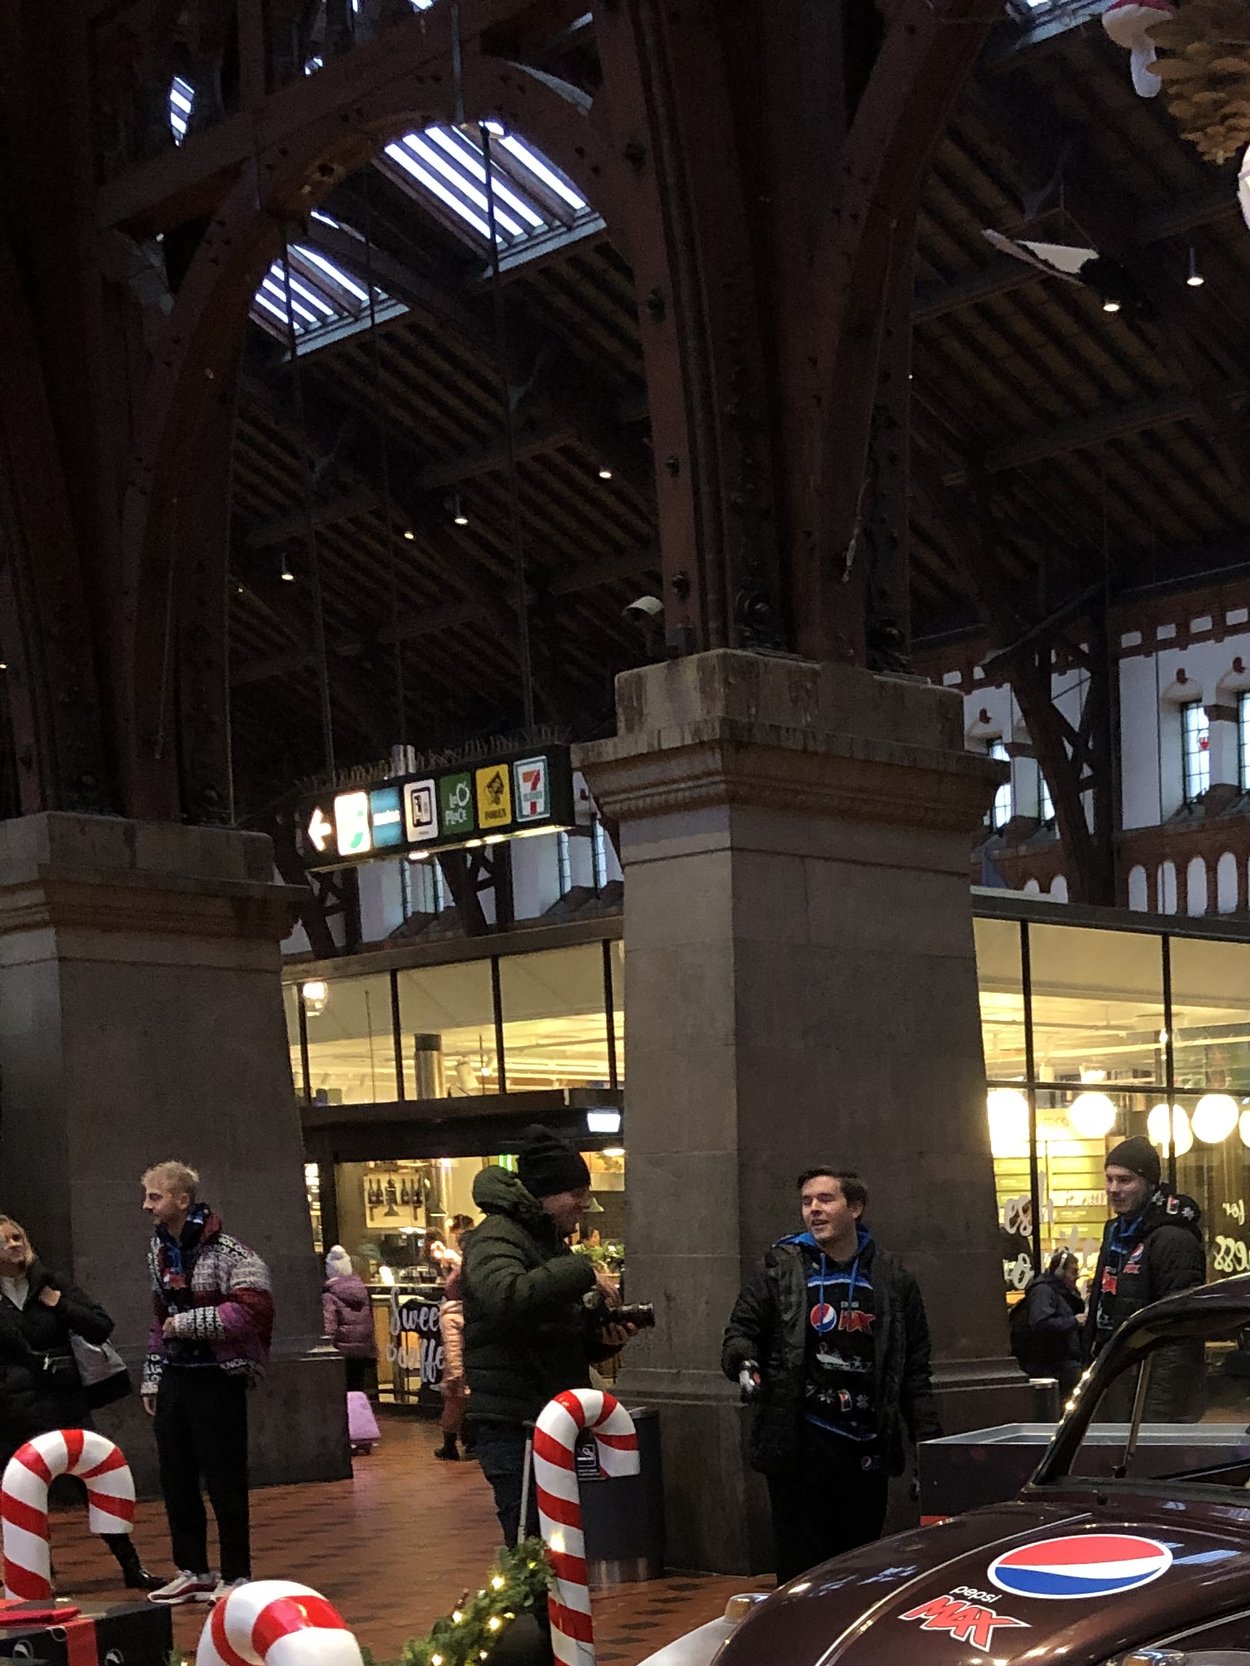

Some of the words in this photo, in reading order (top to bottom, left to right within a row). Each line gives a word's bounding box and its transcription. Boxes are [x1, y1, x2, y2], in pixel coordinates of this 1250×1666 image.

[389, 1285, 442, 1336] Swee
[949, 1585, 1003, 1604] pepsi
[897, 1594, 1033, 1653] MAX
